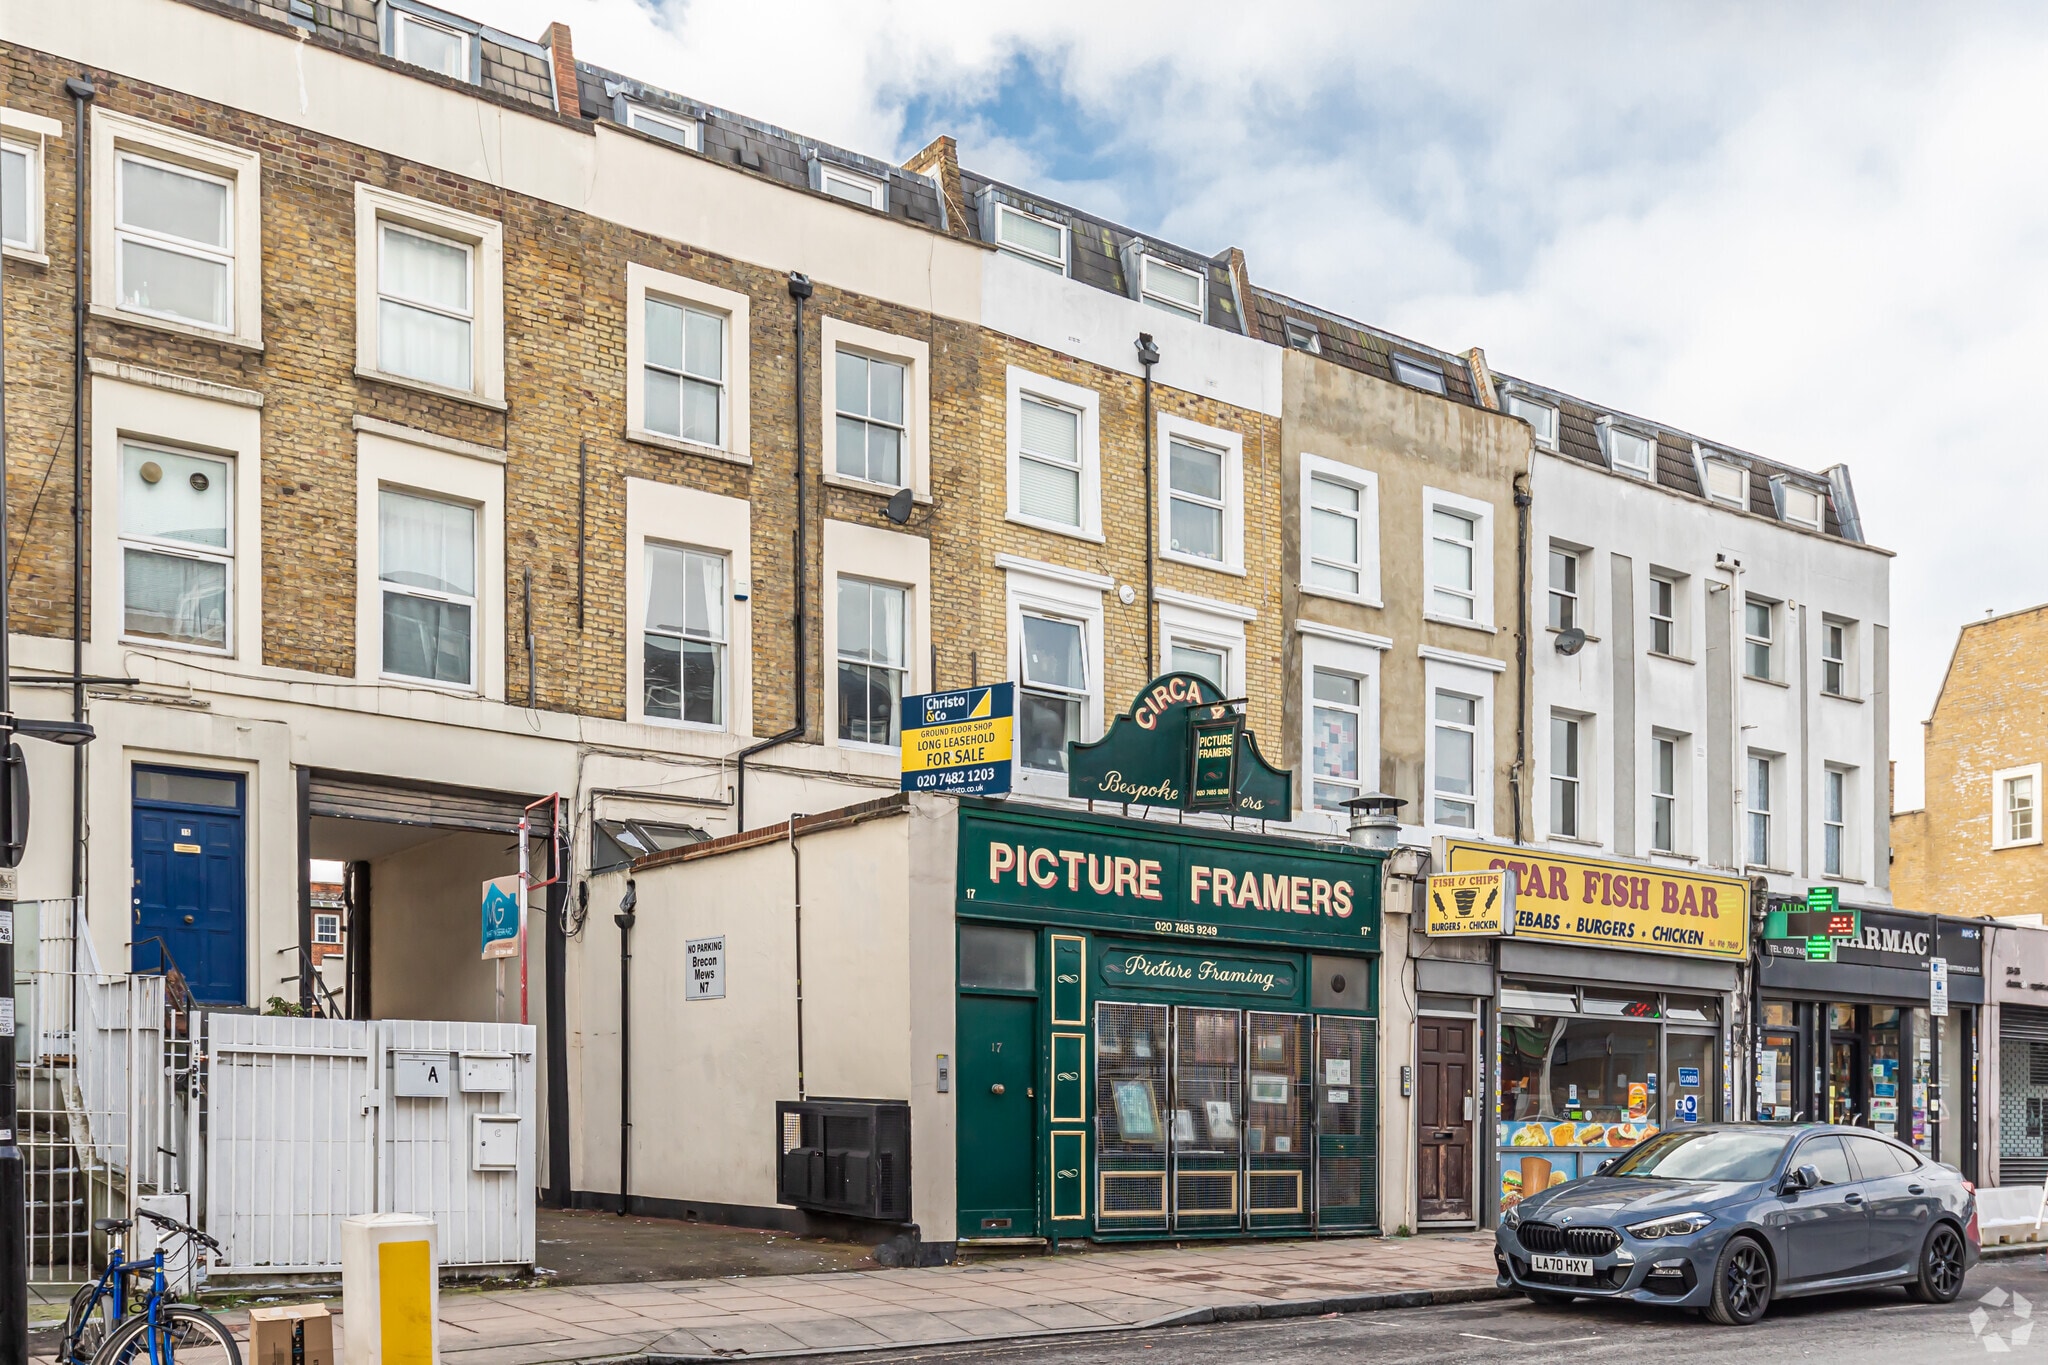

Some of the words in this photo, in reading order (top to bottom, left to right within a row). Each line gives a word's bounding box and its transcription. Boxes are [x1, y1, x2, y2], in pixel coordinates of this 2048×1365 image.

[926, 696, 965, 710] Christo
[1135, 677, 1203, 730] CIRCA
[921, 728, 948, 738] GROUND
[951, 725, 971, 734] FLOOR
[974, 722, 992, 731] SHOP
[918, 740, 941, 751] LONG
[944, 732, 995, 748] LEASEHOLD
[1200, 734, 1232, 747] PICTURE
[927, 752, 950, 767] FOR
[955, 747, 985, 764] SALE
[1199, 748, 1232, 759] FRAMERS
[917, 775, 936, 787] 020
[939, 771, 964, 785] 7482
[968, 768, 994, 782] 1203
[1098, 770, 1178, 803] Bespoke
[990, 841, 1162, 901] PICTURE
[1190, 865, 1353, 918] FRAMERS
[1433, 878, 1455, 888] FISH
[1458, 877, 1466, 886] &
[1469, 875, 1499, 886] CHIPS
[966, 888, 976, 899] 17
[1582, 870, 1650, 911] FISH
[1661, 881, 1719, 919] BAR
[1155, 921, 1172, 933] 020
[1175, 922, 1195, 935] 7485
[1197, 924, 1217, 936] 9249
[1432, 922, 1460, 931] BURGERS
[1469, 920, 1498, 930] CHICKEN
[1576, 917, 1635, 938] BURGERS
[1652, 926, 1704, 945] CHICKEN
[688, 945, 696, 954] NO
[697, 941, 722, 952] PARKING
[1783, 946, 1794, 954] 020
[693, 956, 717, 967] Brecon
[695, 969, 714, 980] Mews
[1125, 954, 1192, 978] Picture
[1198, 961, 1274, 991] Framing
[700, 982, 709, 993] N7
[992, 1042, 1002, 1053] 17
[428, 1066, 439, 1083] A
[1536, 1257, 1562, 1271] LA70
[1566, 1260, 1587, 1272] HXY
